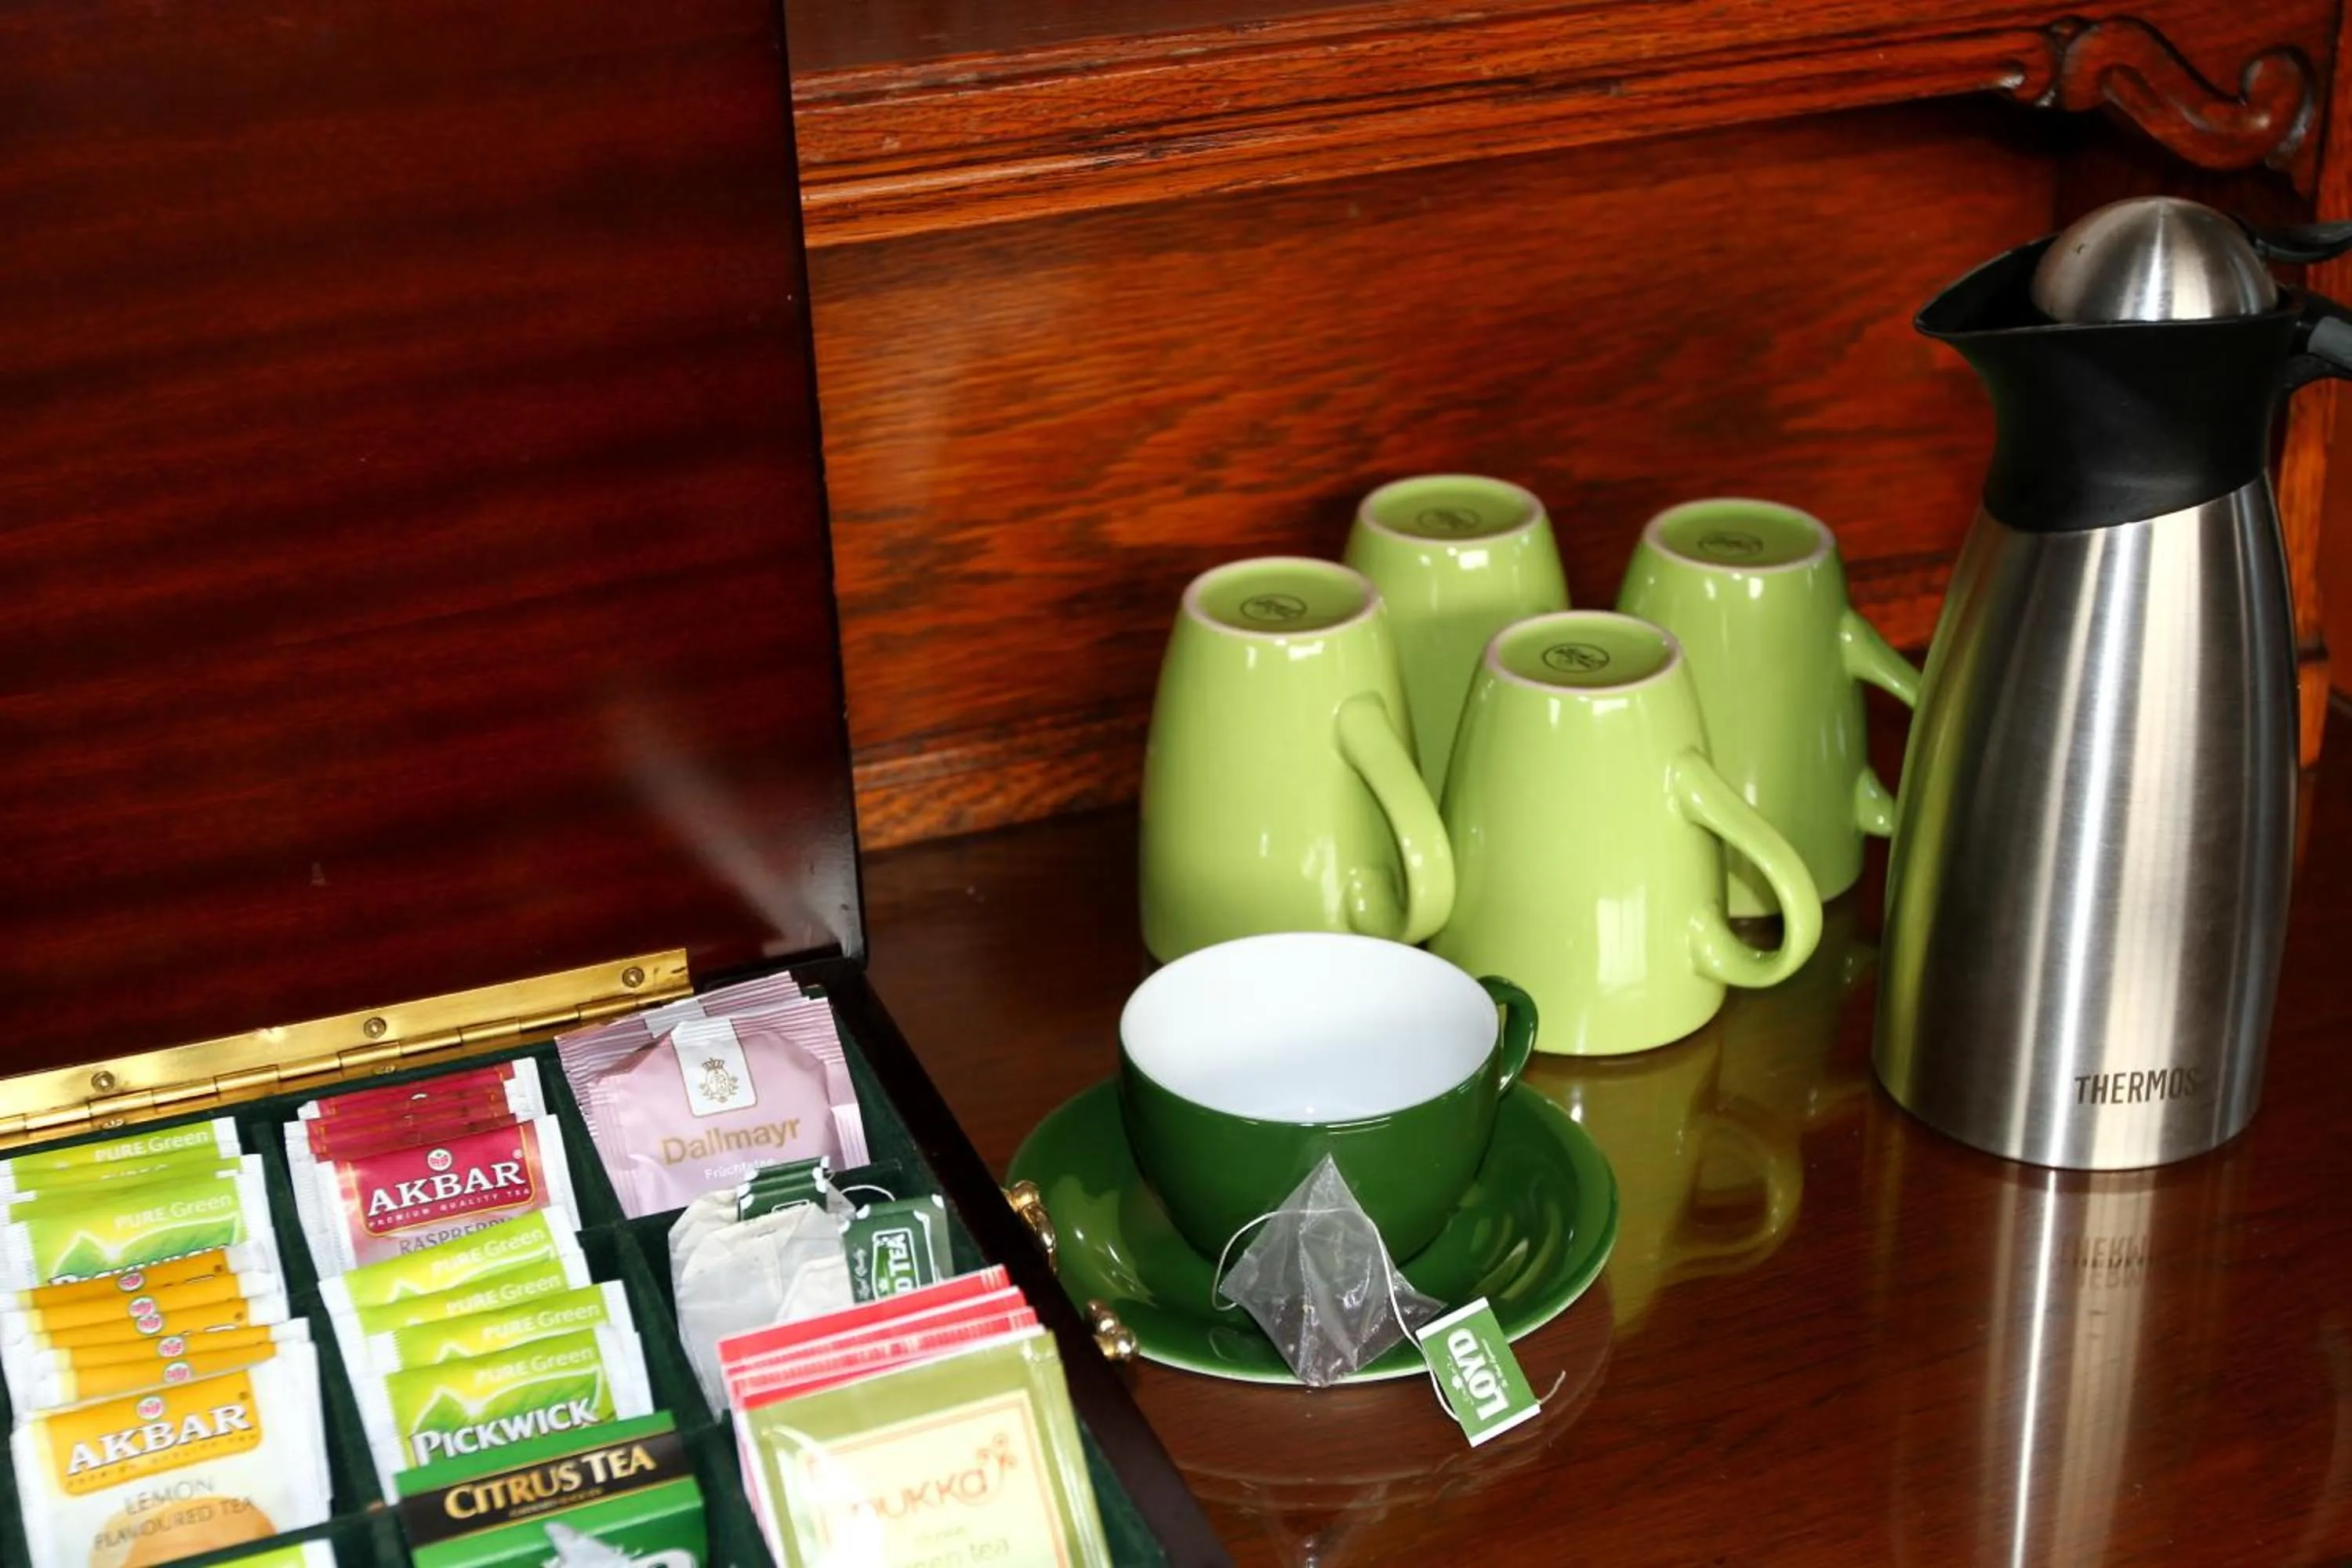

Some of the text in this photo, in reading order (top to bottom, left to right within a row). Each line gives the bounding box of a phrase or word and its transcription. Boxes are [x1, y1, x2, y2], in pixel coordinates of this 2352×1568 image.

[2075, 1066, 2200, 1105] THERMOS
[94, 1131, 209, 1162] PURE Green
[662, 1118, 800, 1166] Dallmayr
[368, 1161, 526, 1218] AKBAR
[368, 1188, 531, 1227] PREMIUM QUALITY TEA
[114, 1194, 231, 1230] PURE Green
[399, 1218, 514, 1254] RASPBER
[431, 1229, 545, 1275] PURE Green
[446, 1275, 560, 1315] PURE Green
[481, 1303, 601, 1340] PURE Green
[474, 1348, 594, 1385] PURE Green
[1447, 1327, 1509, 1421] LOYD
[66, 1404, 252, 1477] AKBAR
[411, 1398, 601, 1467] PICKWICK
[125, 1475, 214, 1515] LEMON
[444, 1460, 583, 1519] CITRUS
[582, 1444, 658, 1485] TEA
[94, 1494, 255, 1551] FLAVOURED TEA
